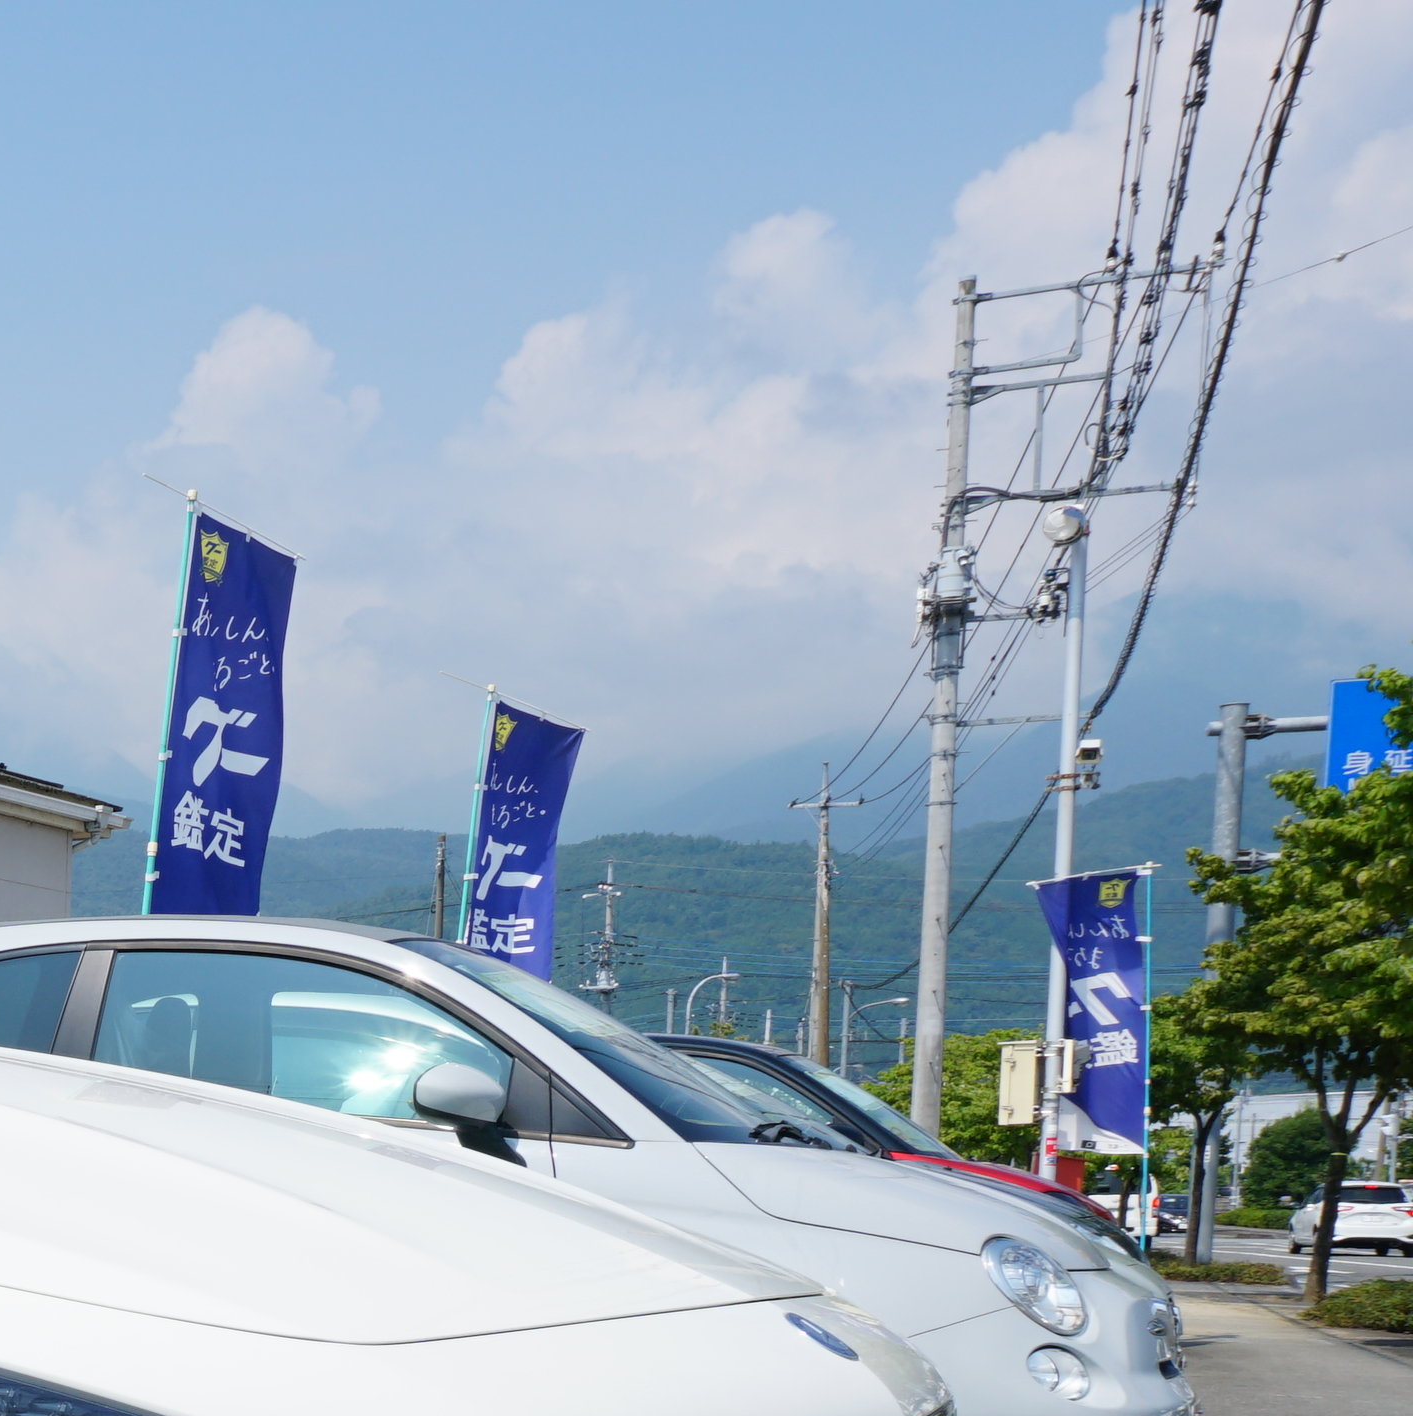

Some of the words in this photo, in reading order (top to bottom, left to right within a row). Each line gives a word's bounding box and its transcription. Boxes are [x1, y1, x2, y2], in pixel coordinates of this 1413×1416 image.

[171, 789, 246, 868] 鑑定
[491, 800, 546, 829] るごと。
